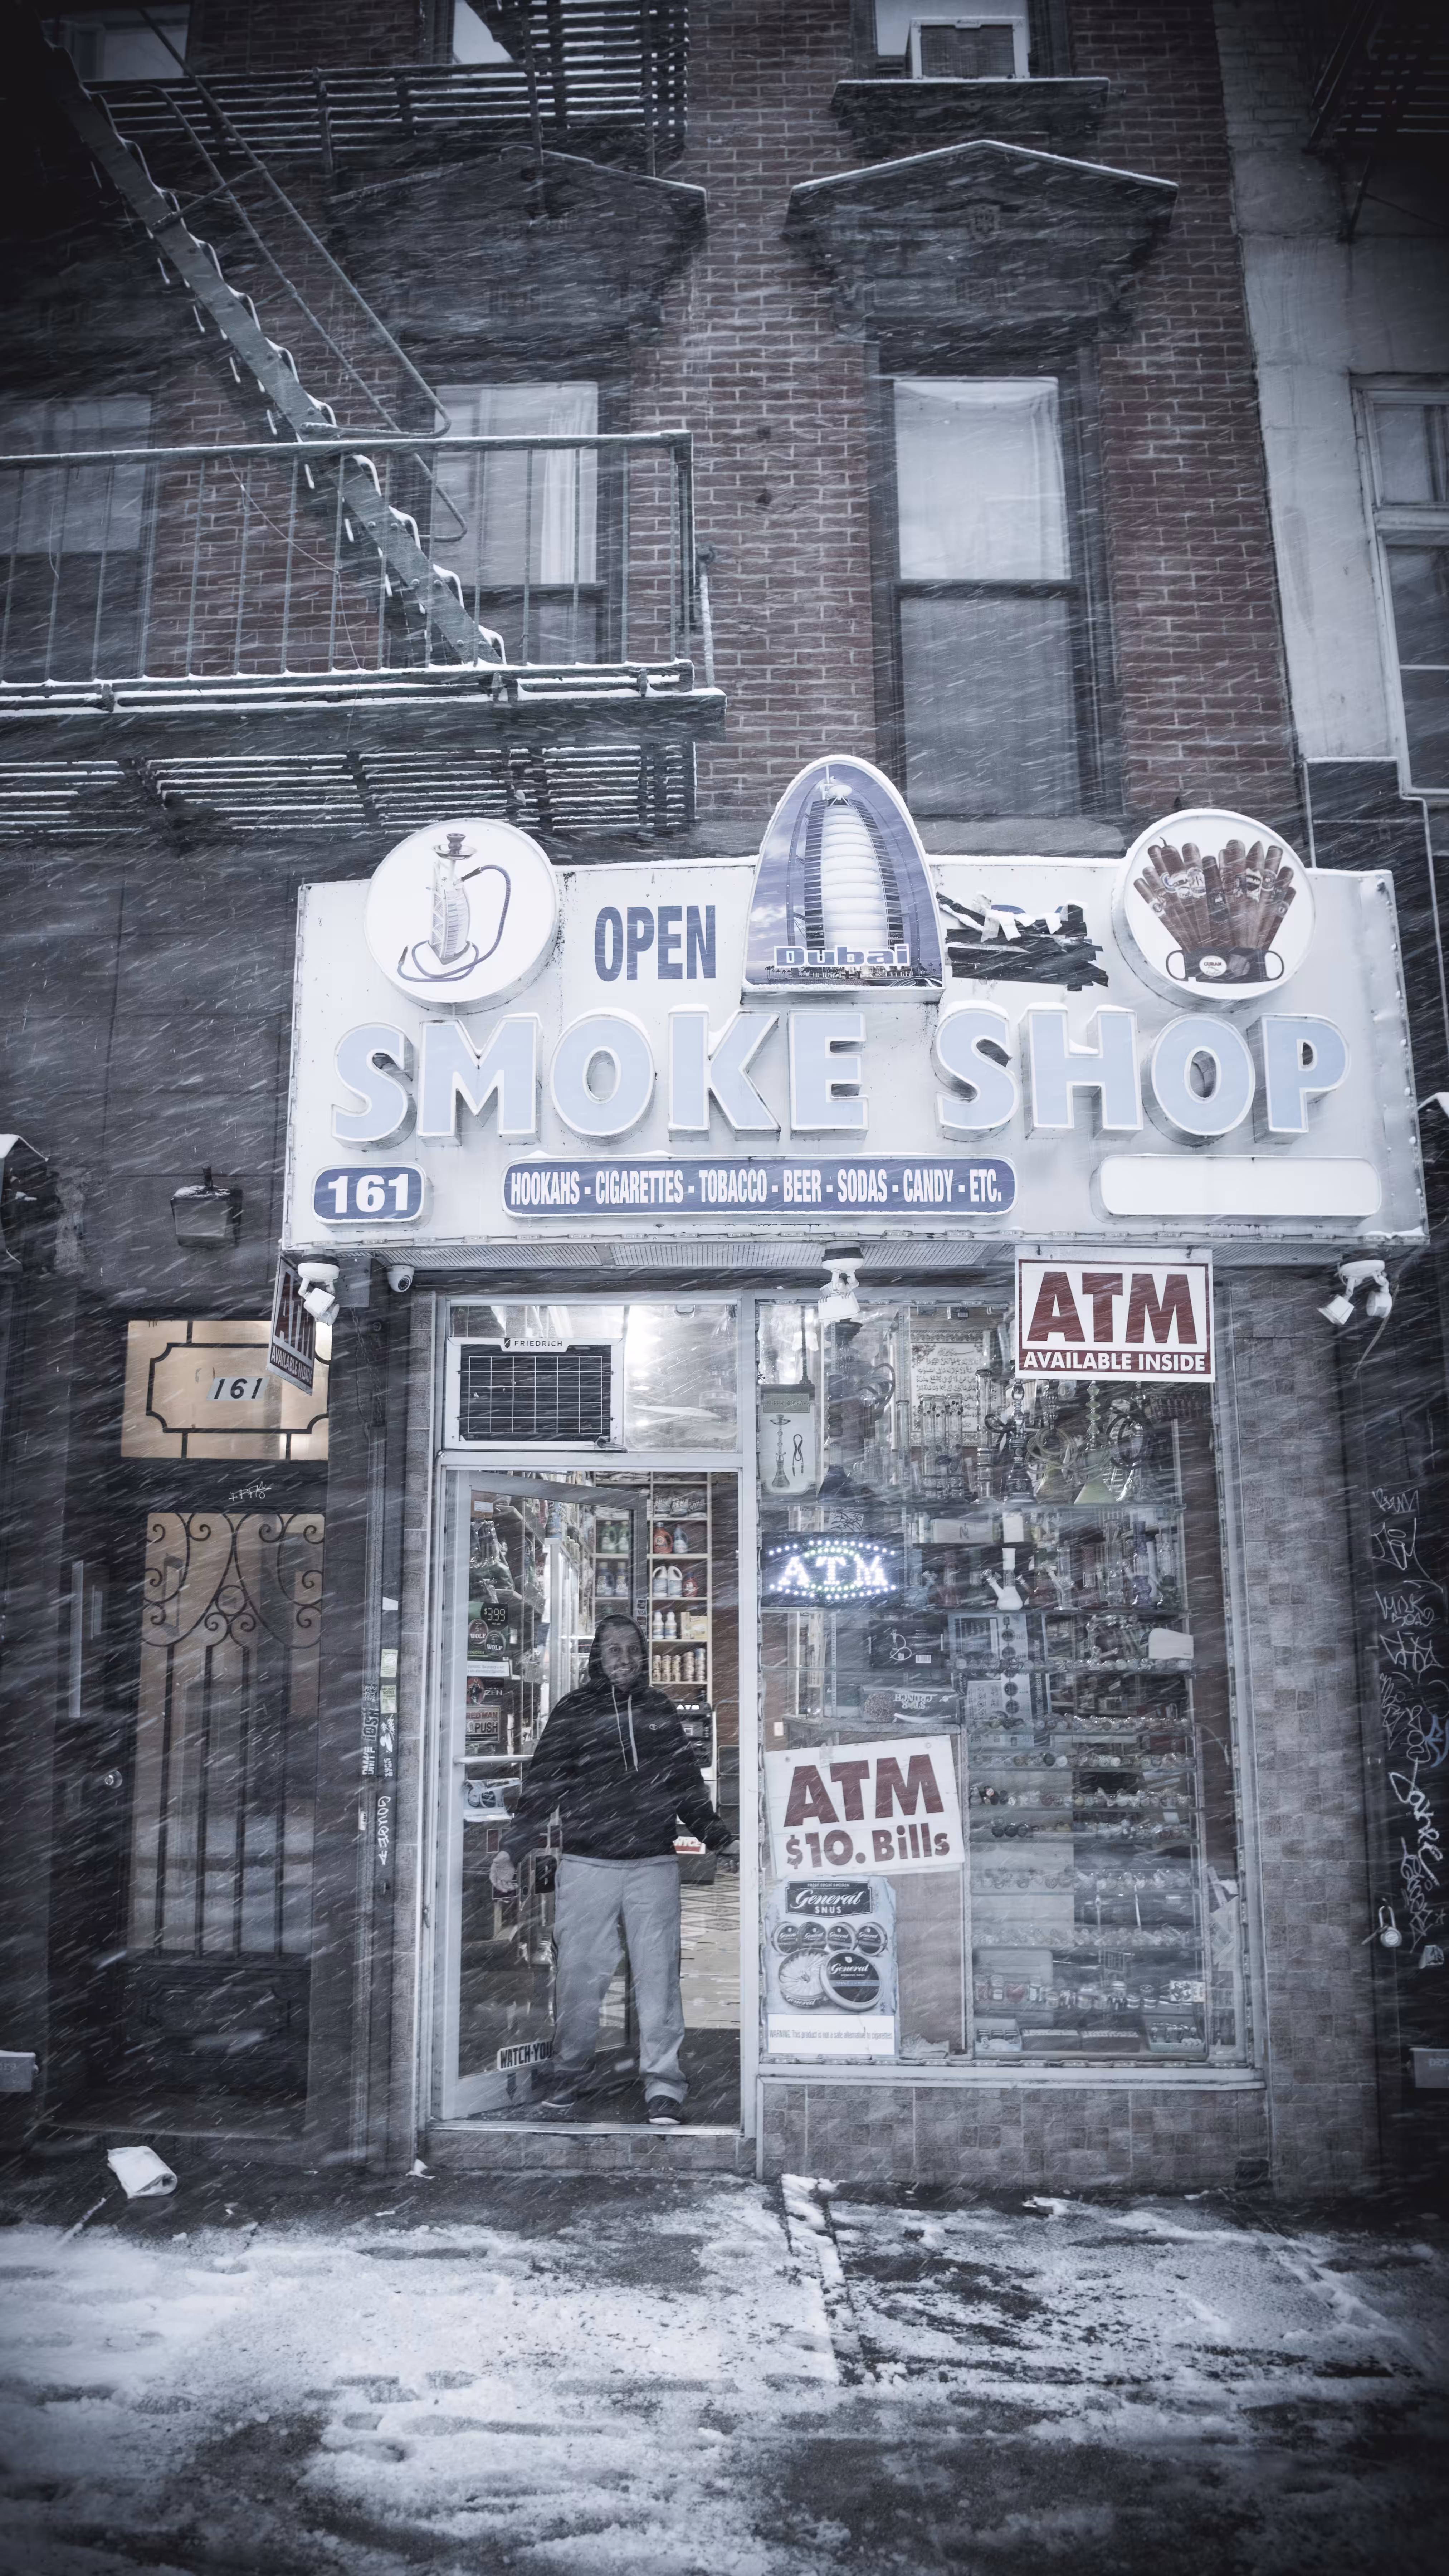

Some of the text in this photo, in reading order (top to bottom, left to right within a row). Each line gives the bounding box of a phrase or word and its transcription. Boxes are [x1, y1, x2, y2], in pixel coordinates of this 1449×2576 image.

[594, 905, 716, 981] OPEN
[774, 943, 910, 967] Dubai
[331, 1007, 1351, 1145] SMOKE SHOP
[328, 1173, 409, 1213] 161
[511, 1168, 1002, 1205] HOOKAHS CIGARETTES TOBACCO BEER SODAS CANDY ETC.
[1027, 1271, 1197, 1344] ATM
[514, 1340, 562, 1348] FRIEDRICH
[271, 1345, 313, 1384] AVAILABLE INSIDE
[1023, 1352, 1206, 1372] AVAILABLE INSIDE
[214, 1378, 263, 1400] 161
[778, 1556, 888, 1587] ATM
[484, 1607, 506, 1621] $3.99
[893, 1693, 933, 1702] CRUNCH
[475, 1722, 498, 1733] PUSH
[783, 1753, 945, 1827] ATM
[377, 1795, 391, 1848] GOUGE
[786, 1823, 950, 1869] $10. Bills
[790, 1889, 865, 1909] General
[831, 1963, 869, 1974] General
[792, 2030, 801, 2038] This
